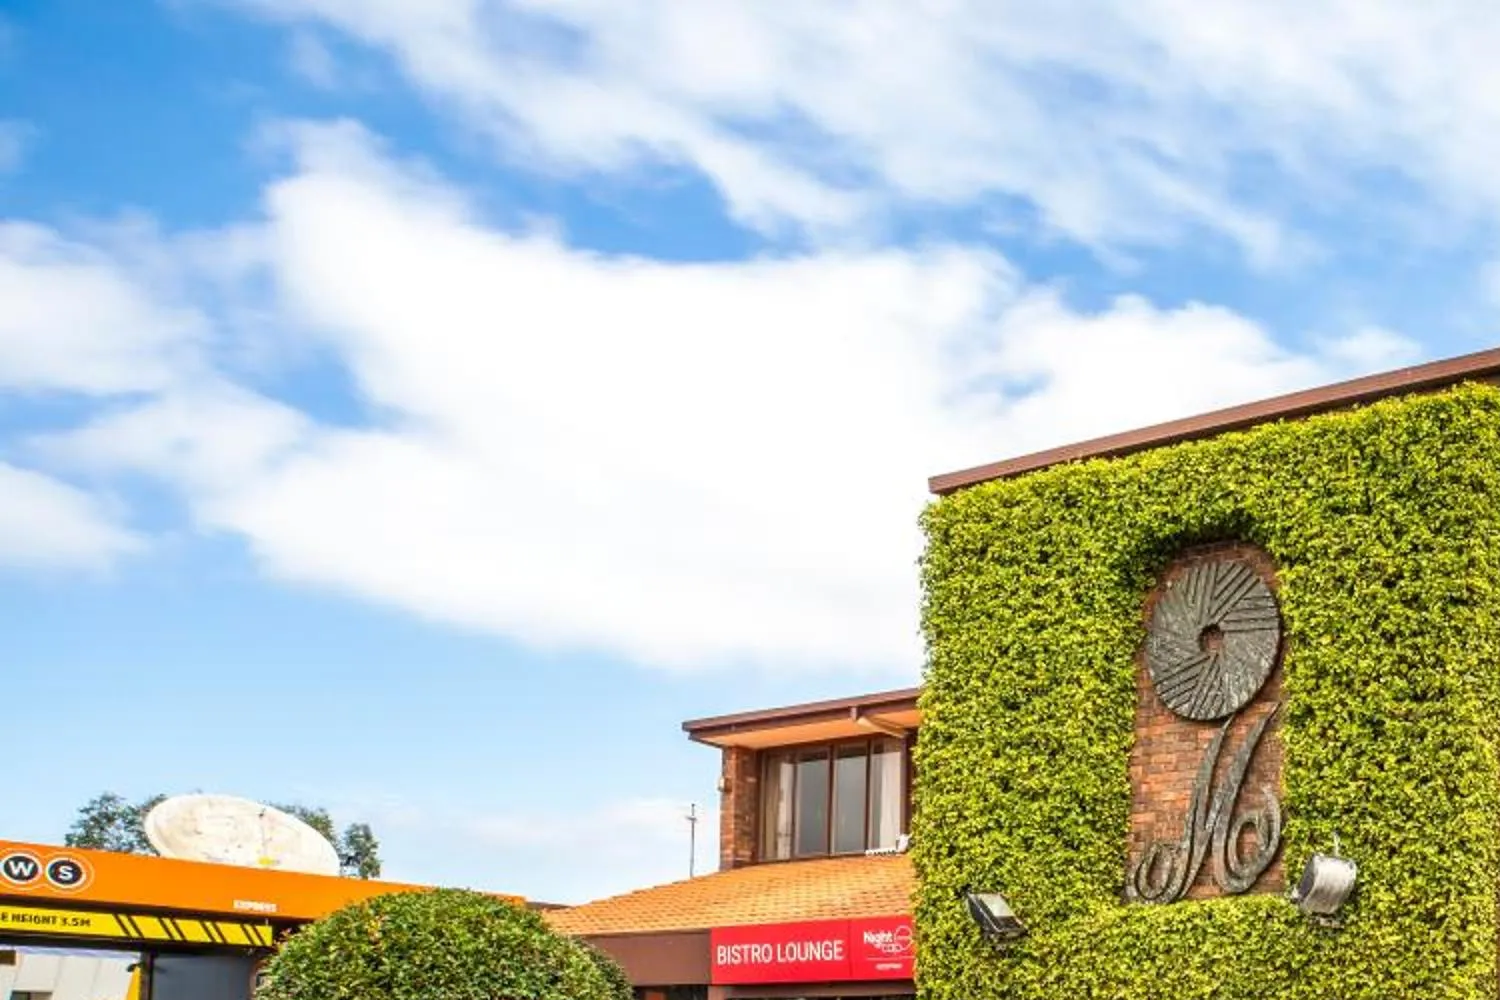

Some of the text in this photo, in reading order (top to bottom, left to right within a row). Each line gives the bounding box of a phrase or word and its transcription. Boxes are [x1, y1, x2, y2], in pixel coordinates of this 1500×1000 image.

[12, 913, 58, 925] HEIGHT
[717, 940, 844, 965] BISTRO LOUNGE
